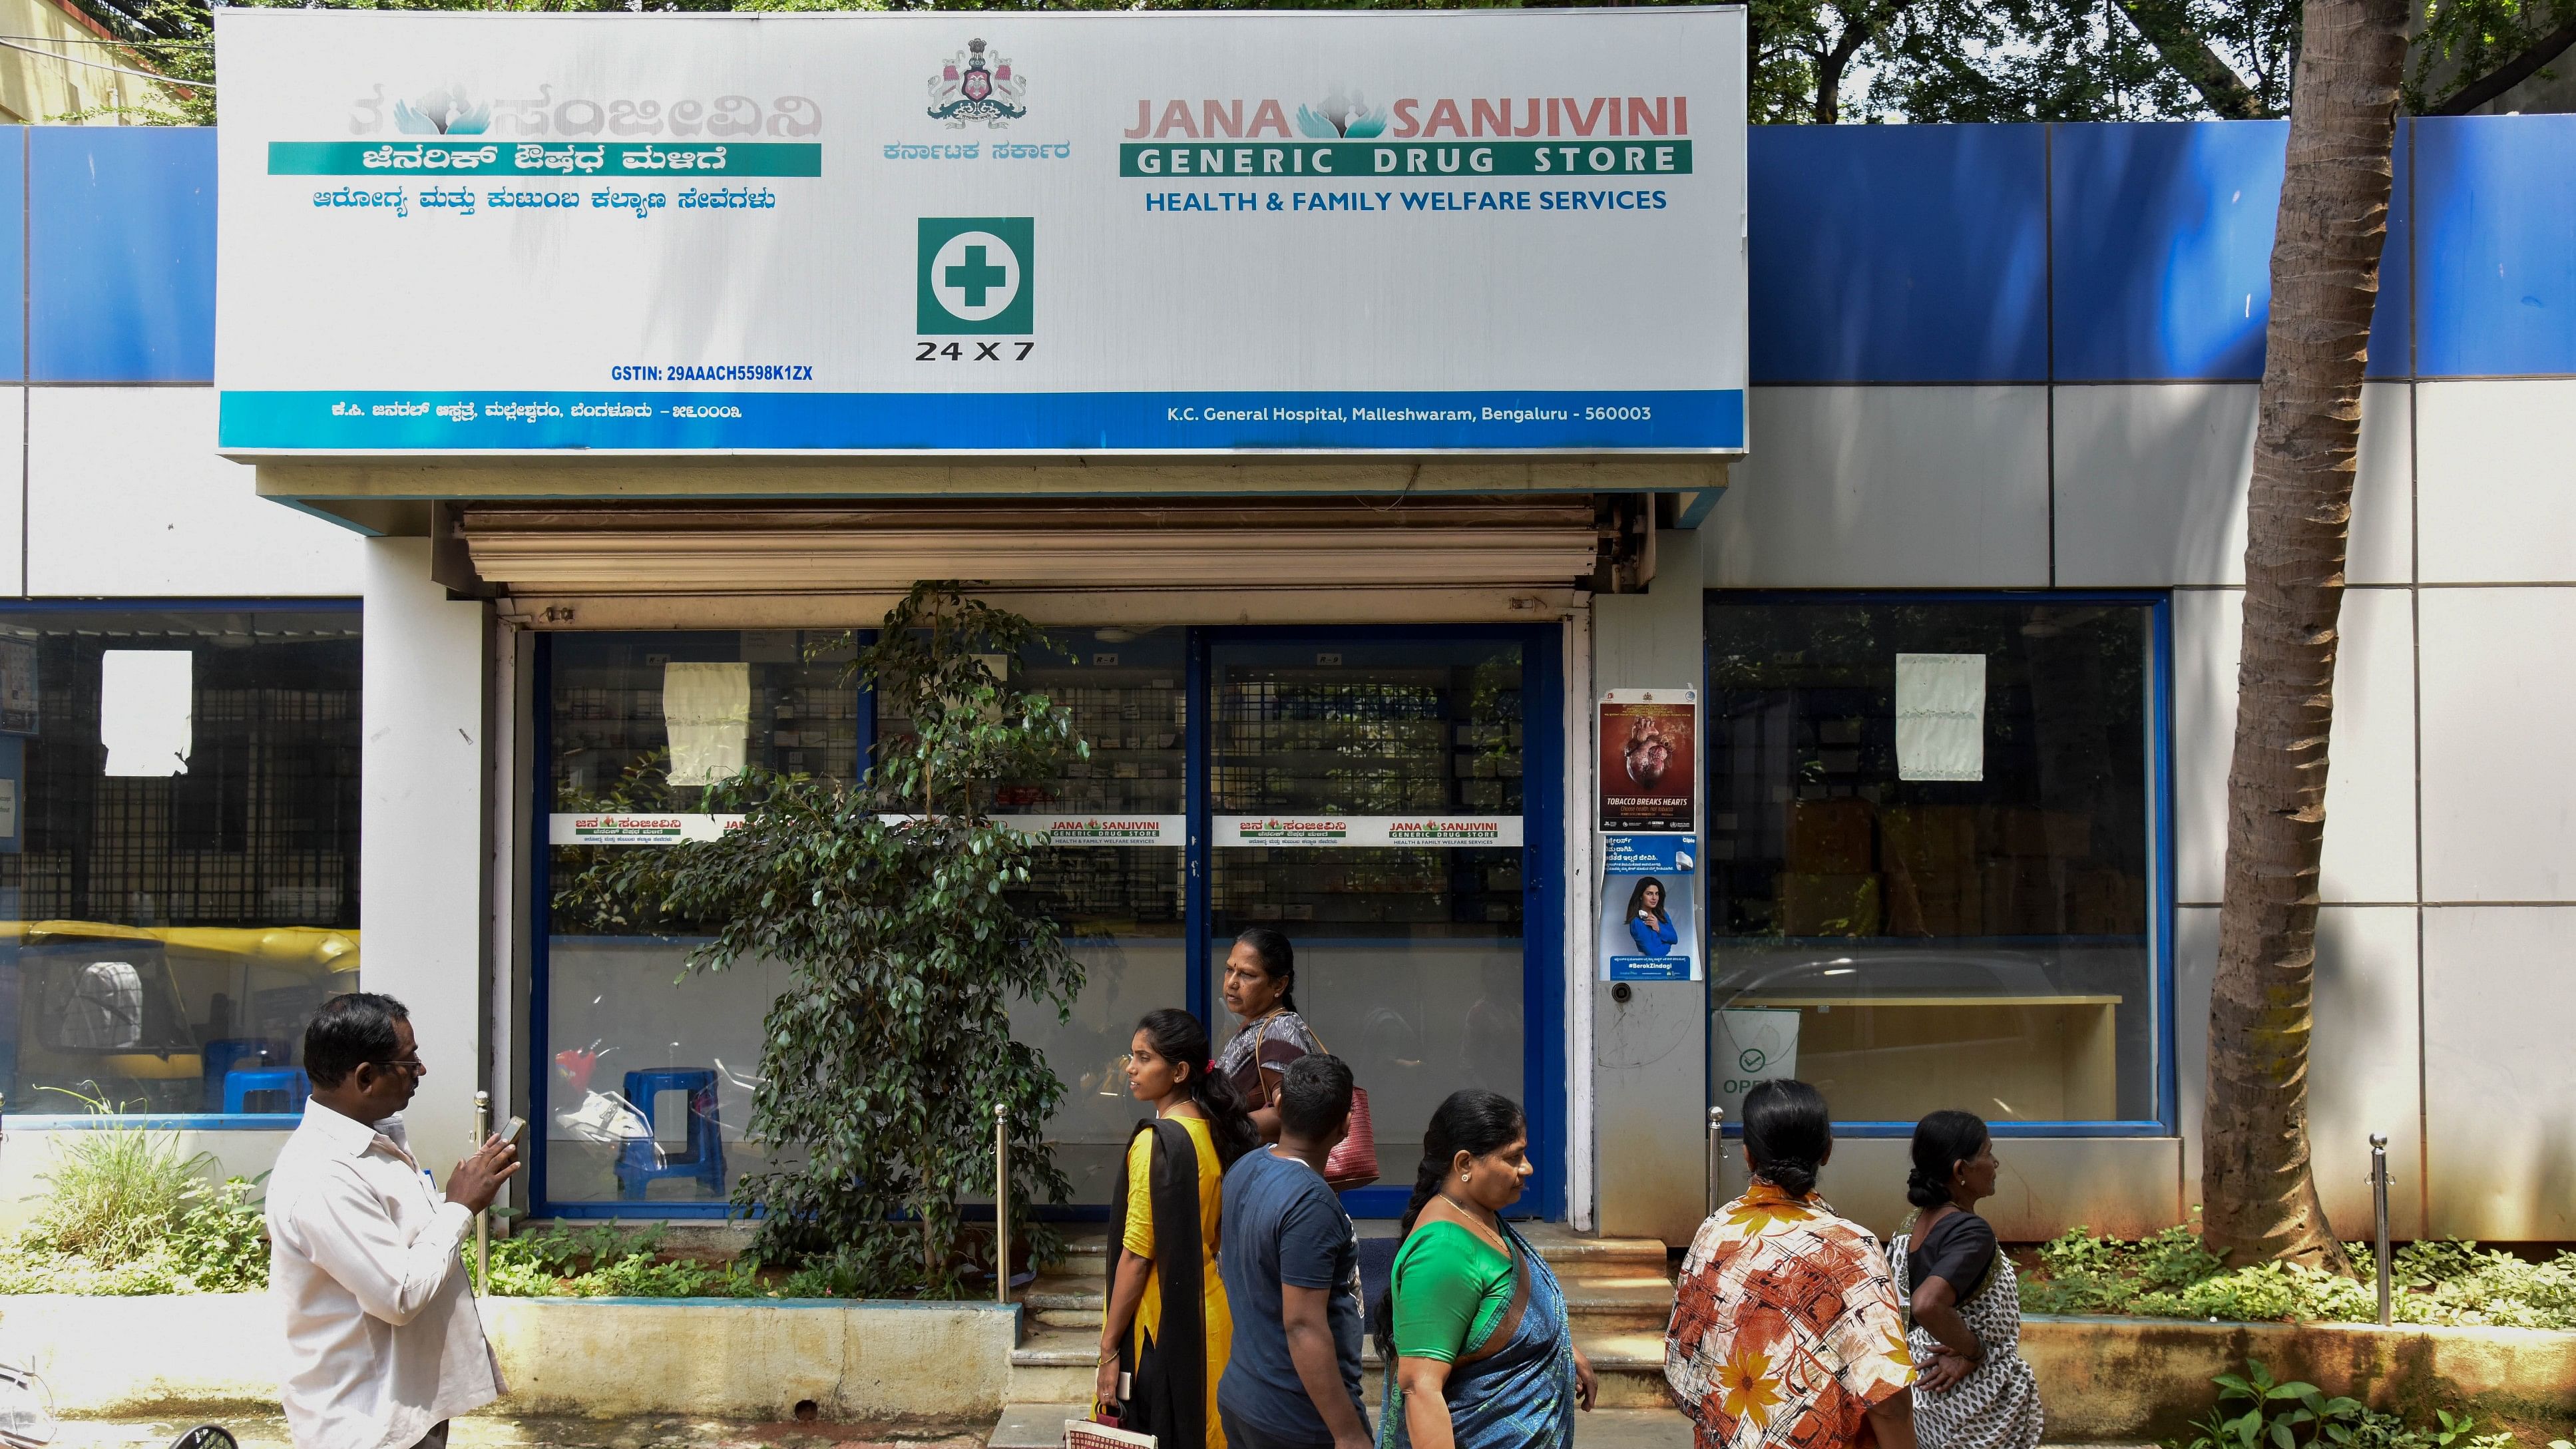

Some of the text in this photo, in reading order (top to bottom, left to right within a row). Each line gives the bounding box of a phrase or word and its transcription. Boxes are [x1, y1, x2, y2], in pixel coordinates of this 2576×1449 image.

[493, 83, 823, 138] ಸಂಜೀವಿನಿ
[1124, 96, 1687, 138] JANA SANJIVINI
[363, 144, 727, 174] ಜೆನರಿಕ್ ಔಷಧ ಮಳಿಗೆ
[884, 139, 1070, 160] ಕರ್ನಾಟಕ ಸರ್ಕಾರ
[1137, 146, 1675, 174] GENERIC DRUG STORE
[313, 186, 775, 219] ಆರೋಗ್ಯ ಮತ್ತು ಕುಟುಂಬ ಕಲ್ಯಾಣ ಸೇವೆಗಳು
[1146, 190, 1666, 212] HEALTH & FAMILY WELFARE SERVICES
[915, 341, 1034, 361] 24 X 7
[611, 365, 813, 381] GSTIN: 29AAACH5598K1ZX
[371, 401, 431, 417] ಜನರಲ್
[570, 401, 653, 418] ಬೆಂಗಳೂರು
[1168, 407, 1199, 421] K.C.
[1203, 407, 1268, 421] General
[1273, 407, 1347, 424] Hospital,
[1352, 407, 1477, 423] Malleshwaram,
[1482, 407, 1568, 423] Bengaluru
[1585, 407, 1651, 421] 560003
[576, 817, 681, 828] ಜನ ಸಂಜೀವಿನಿ
[1240, 820, 1347, 830] ಜನ ಸಂಜೀವಿನಿ
[1389, 822, 1498, 831] JANA SANJIVINI
